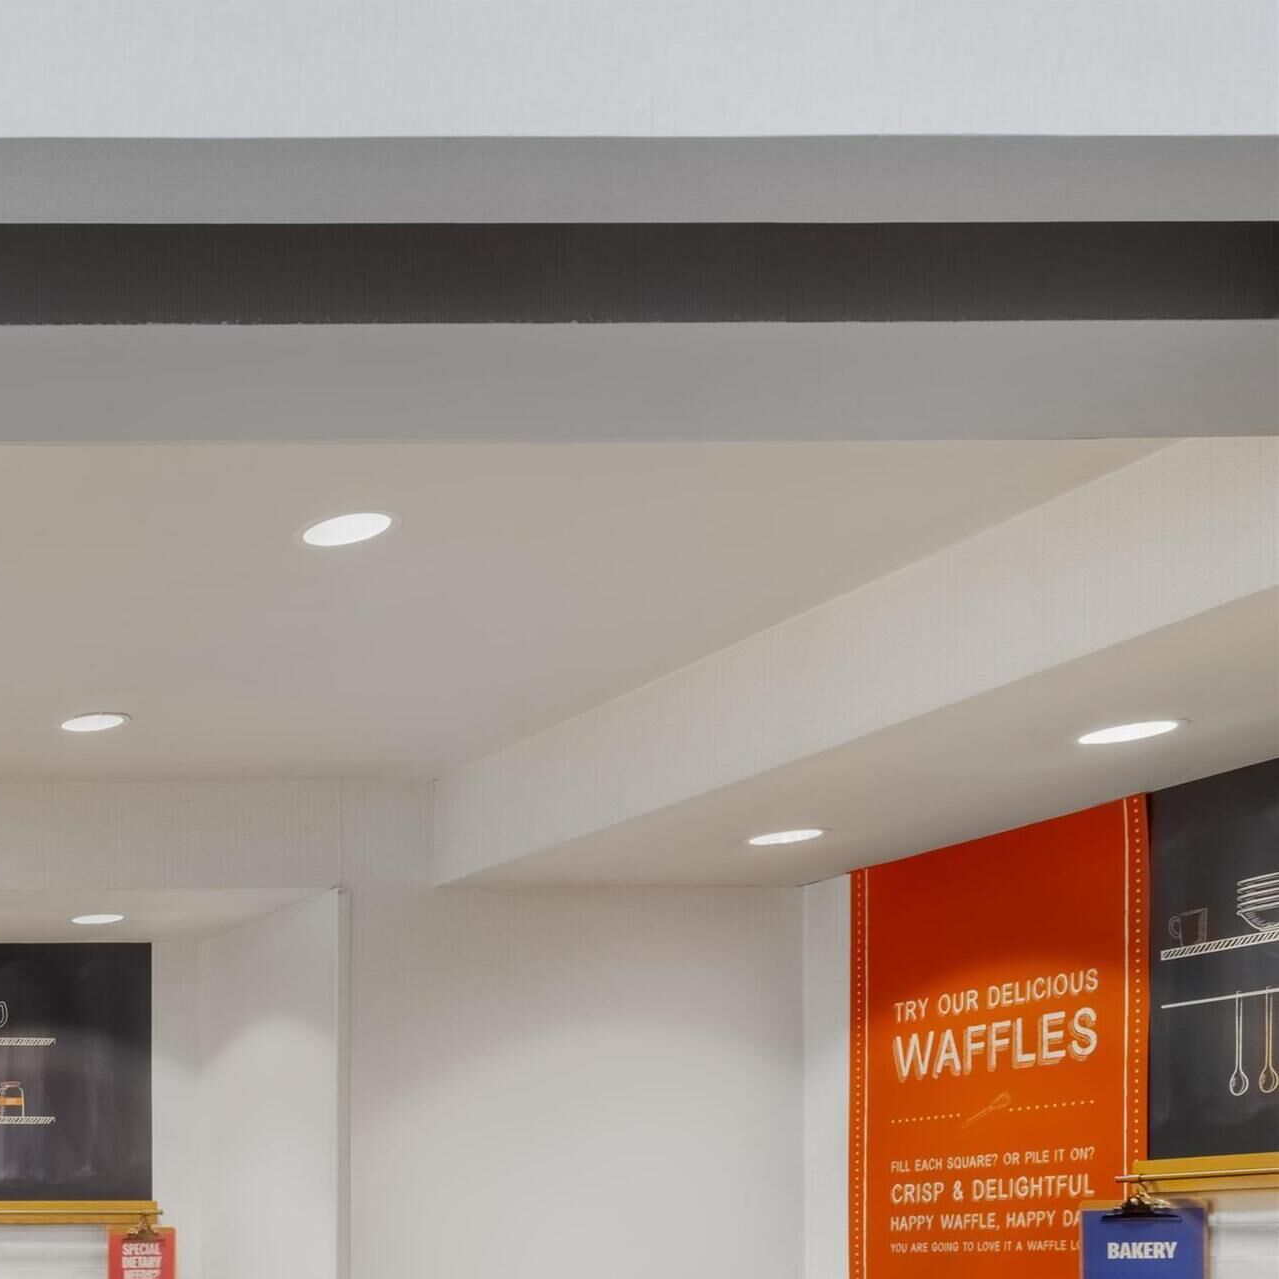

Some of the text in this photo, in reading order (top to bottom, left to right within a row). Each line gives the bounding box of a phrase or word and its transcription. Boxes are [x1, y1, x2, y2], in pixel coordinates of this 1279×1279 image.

[894, 968, 1099, 1023] TRY OUR DELICIOUS
[893, 1007, 1098, 1083] WAFFLES
[891, 1146, 1095, 1173] FILL EACH SQUARE? OR PILE IT ON?
[890, 1173, 1095, 1205] CRISP & DELIGHTFUL
[890, 1214, 934, 1231] HAPPY
[940, 1212, 1001, 1231] WAFFLE,
[1006, 1210, 1056, 1228] HAPPY
[122, 1242, 162, 1256] SPECIAL
[890, 1242, 907, 1253] YOU
[910, 1242, 929, 1252] ARE
[931, 1241, 959, 1252] GOING
[963, 1241, 974, 1252] TO
[977, 1241, 1000, 1252] LOVE
[1004, 1240, 1012, 1251] IT
[1015, 1240, 1023, 1251] A
[1027, 1240, 1067, 1251] WAFFLE
[1107, 1241, 1178, 1259] BAKERY
[122, 1256, 162, 1269] DIETARY
